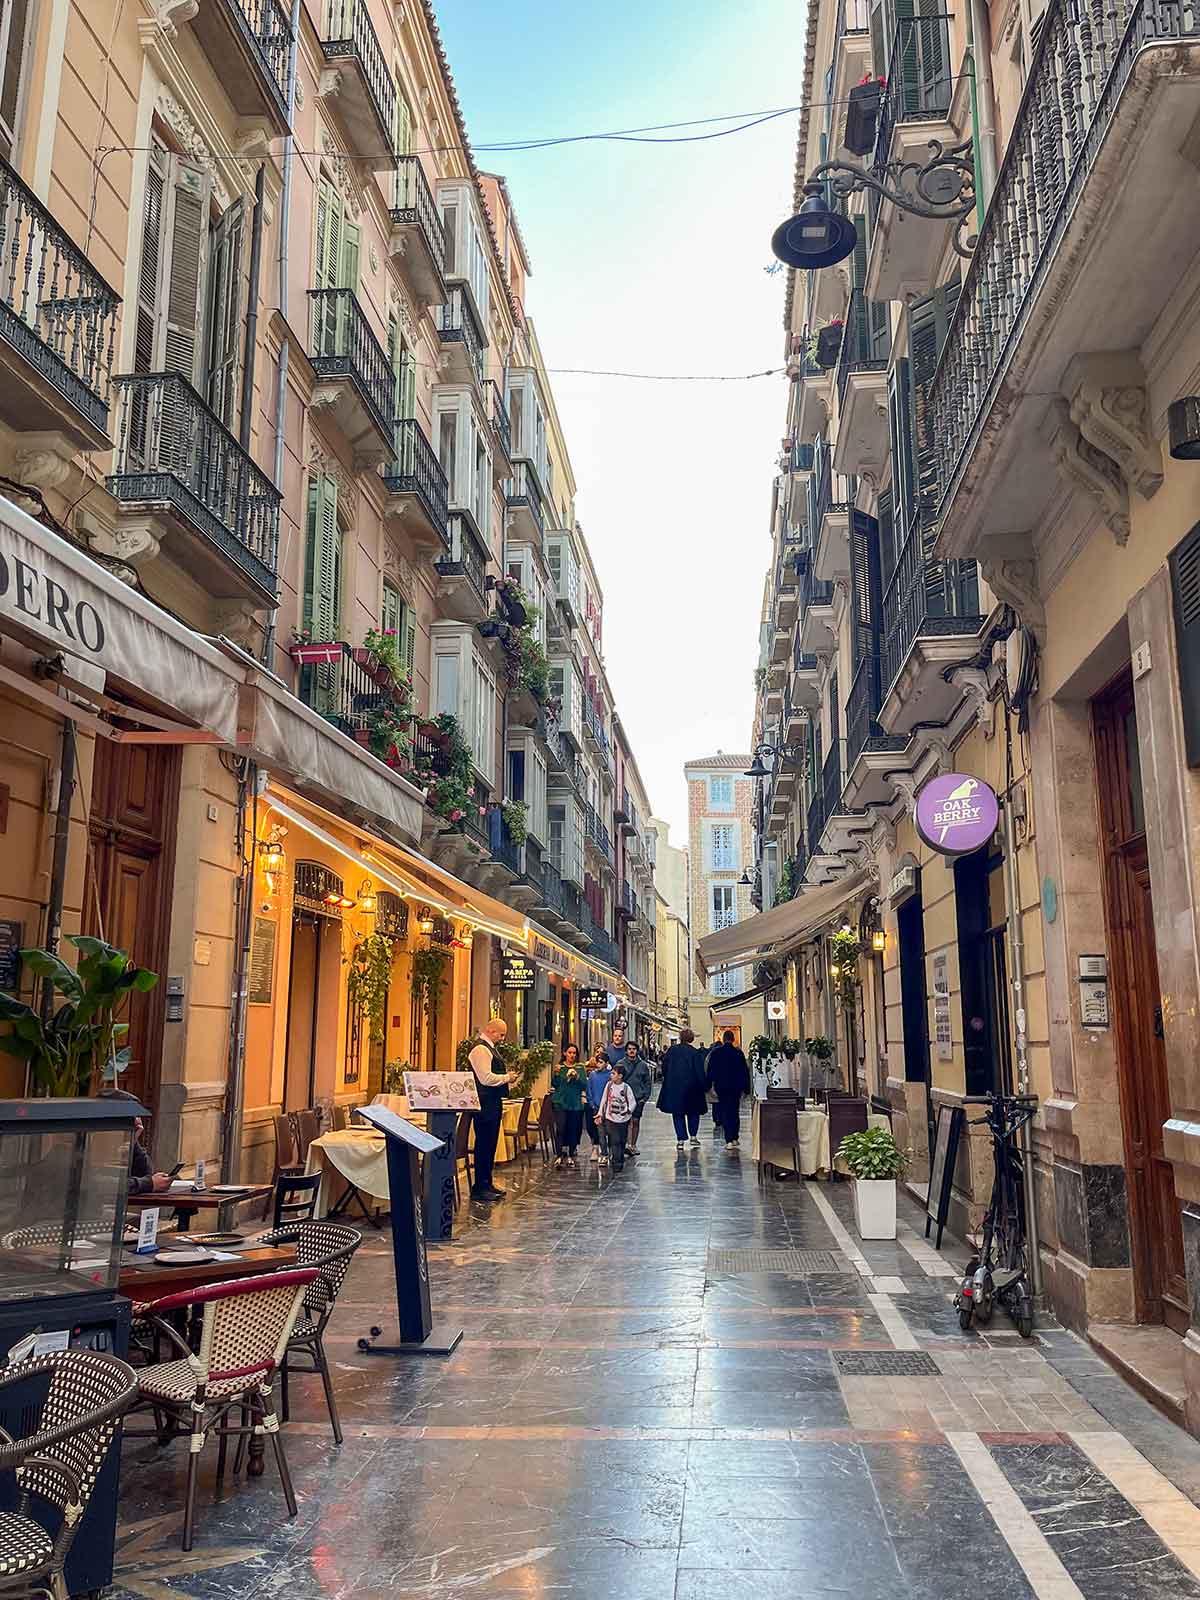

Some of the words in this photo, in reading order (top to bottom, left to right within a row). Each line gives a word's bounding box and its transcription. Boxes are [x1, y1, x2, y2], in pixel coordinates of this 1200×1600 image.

[943, 799, 972, 811] OAK
[934, 807, 982, 823] BERRY
[503, 968, 534, 976] PAMPA
